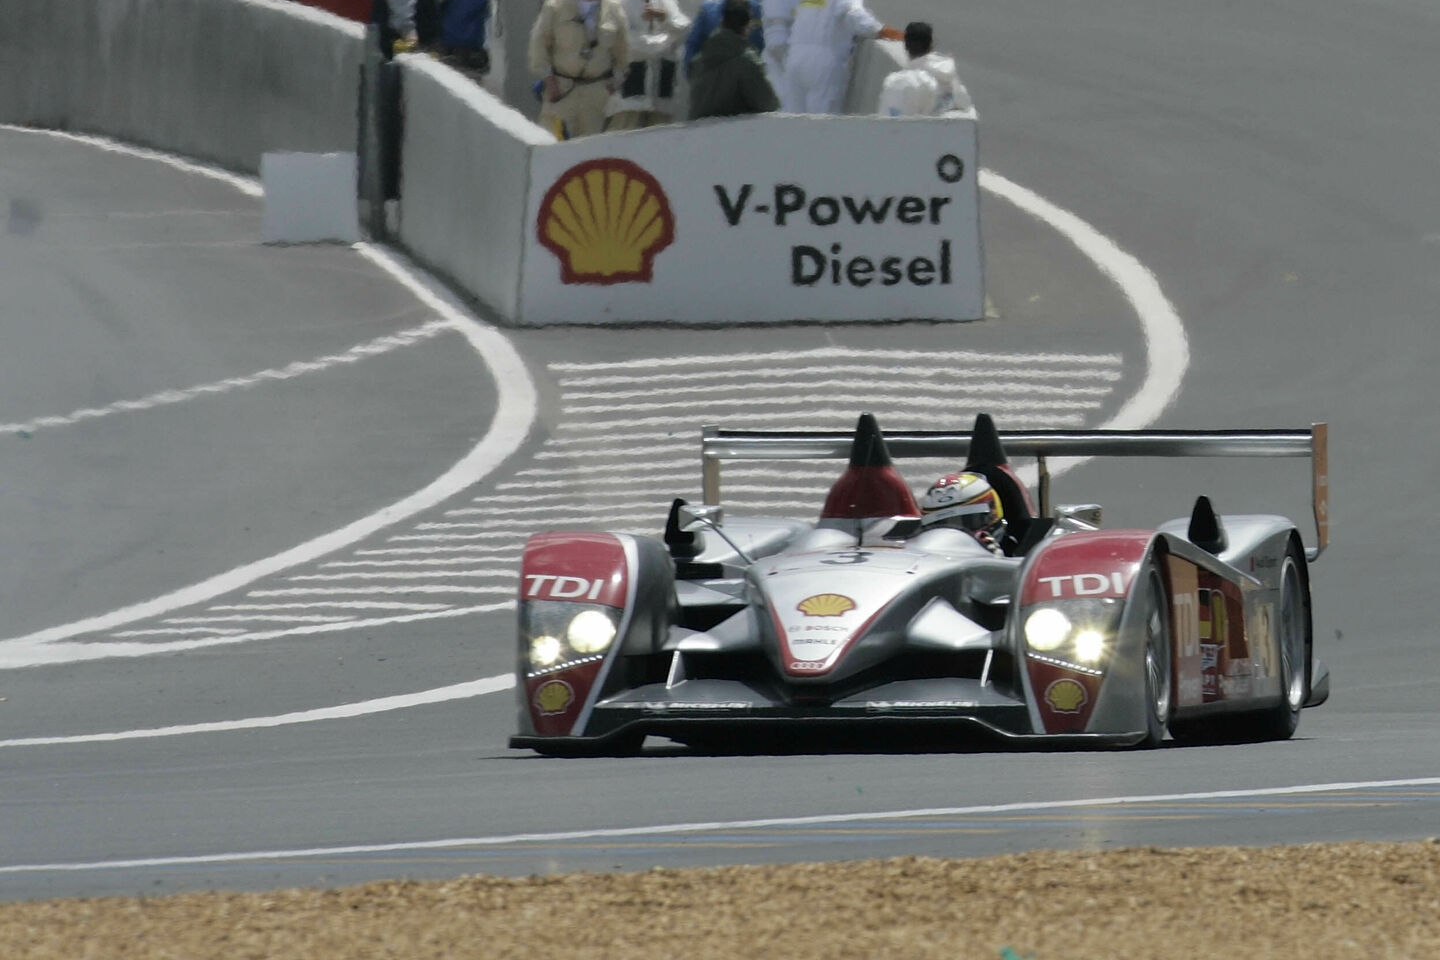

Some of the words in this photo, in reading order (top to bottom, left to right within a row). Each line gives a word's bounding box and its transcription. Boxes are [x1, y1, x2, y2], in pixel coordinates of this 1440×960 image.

[714, 184, 952, 226] V-Power
[791, 239, 952, 287] Diesel
[819, 550, 875, 565] 3
[524, 574, 605, 600] TDI
[1039, 572, 1126, 597] TDI
[804, 624, 849, 632] BOSCH
